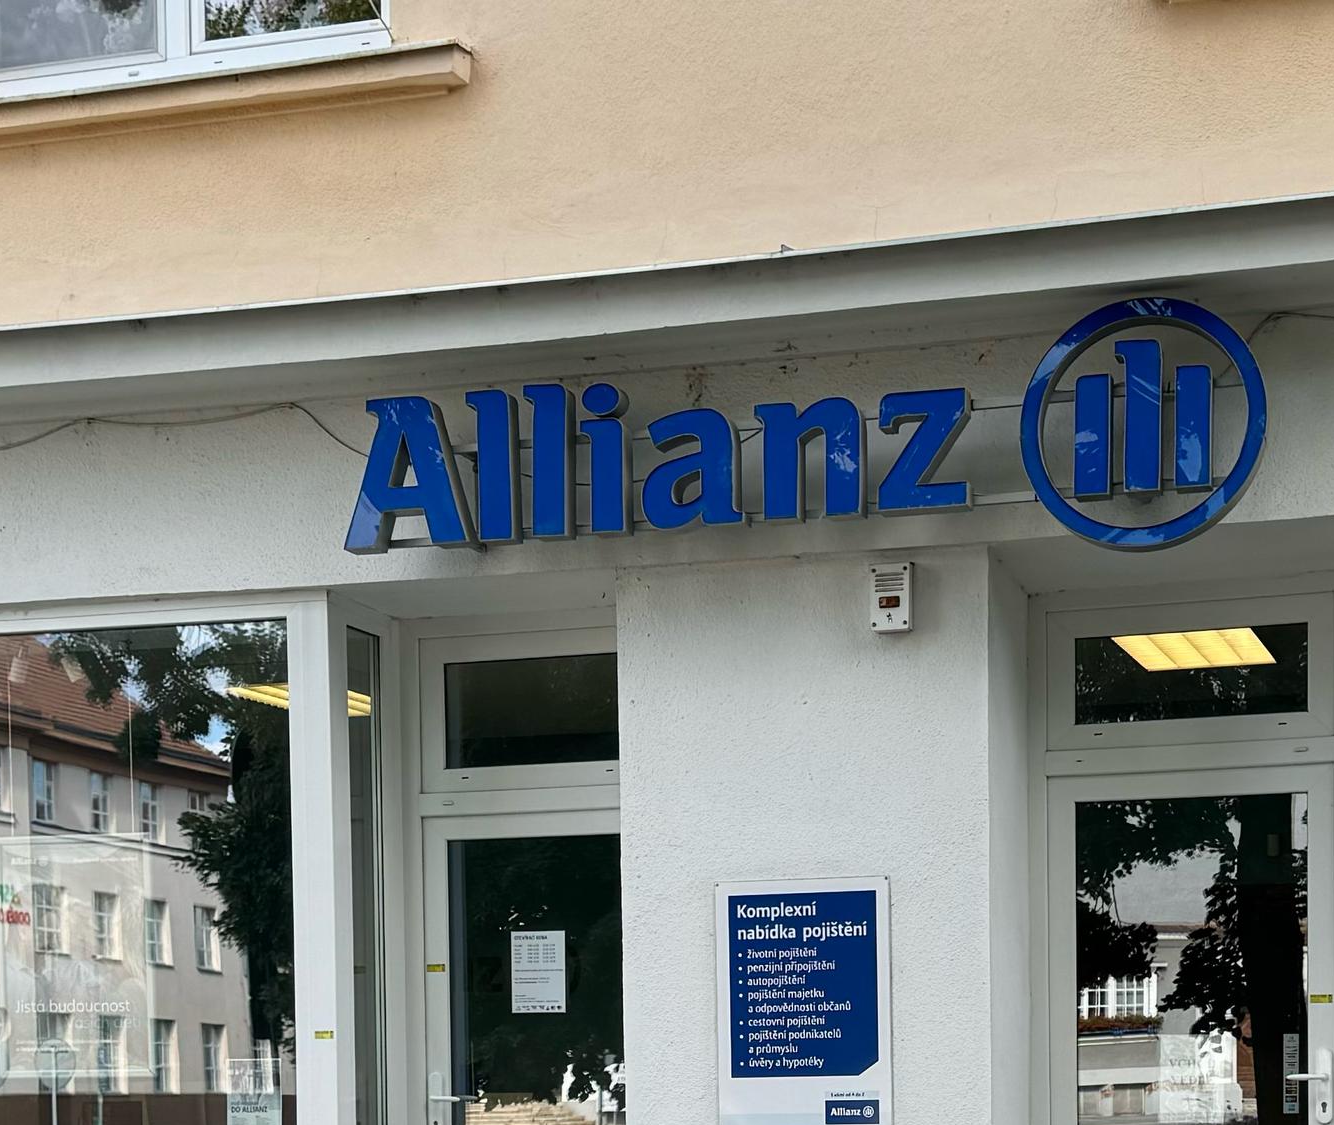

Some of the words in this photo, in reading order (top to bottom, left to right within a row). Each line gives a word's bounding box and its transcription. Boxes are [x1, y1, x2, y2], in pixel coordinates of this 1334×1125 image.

[344, 382, 972, 555] Allianz
[737, 901, 817, 921] Komplexní
[737, 923, 796, 940] nabídka
[803, 921, 867, 941] pojištění
[747, 948, 777, 959] životní
[778, 947, 817, 960] pojištění
[747, 962, 783, 974] penzijní
[784, 960, 835, 973] připojištění
[747, 974, 805, 987] autopojištění
[748, 988, 786, 1001] pojištění
[788, 988, 824, 1000] majetku
[15, 1000, 45, 1013] Jistá
[49, 1000, 130, 1013] budoucnost
[756, 1002, 816, 1015] odpovědnosti
[817, 1000, 851, 1012] občanů
[748, 1016, 785, 1027] cestovní
[787, 1015, 825, 1028] pojištění
[748, 1029, 786, 1042] pojištění
[788, 1029, 842, 1041] podnikatelů
[756, 1043, 798, 1055] průmyslu
[749, 1057, 774, 1069] úvěry
[782, 1056, 824, 1069] hypotéky
[242, 1105, 268, 1113] ALLIANZ
[830, 1107, 861, 1116] Allianz
